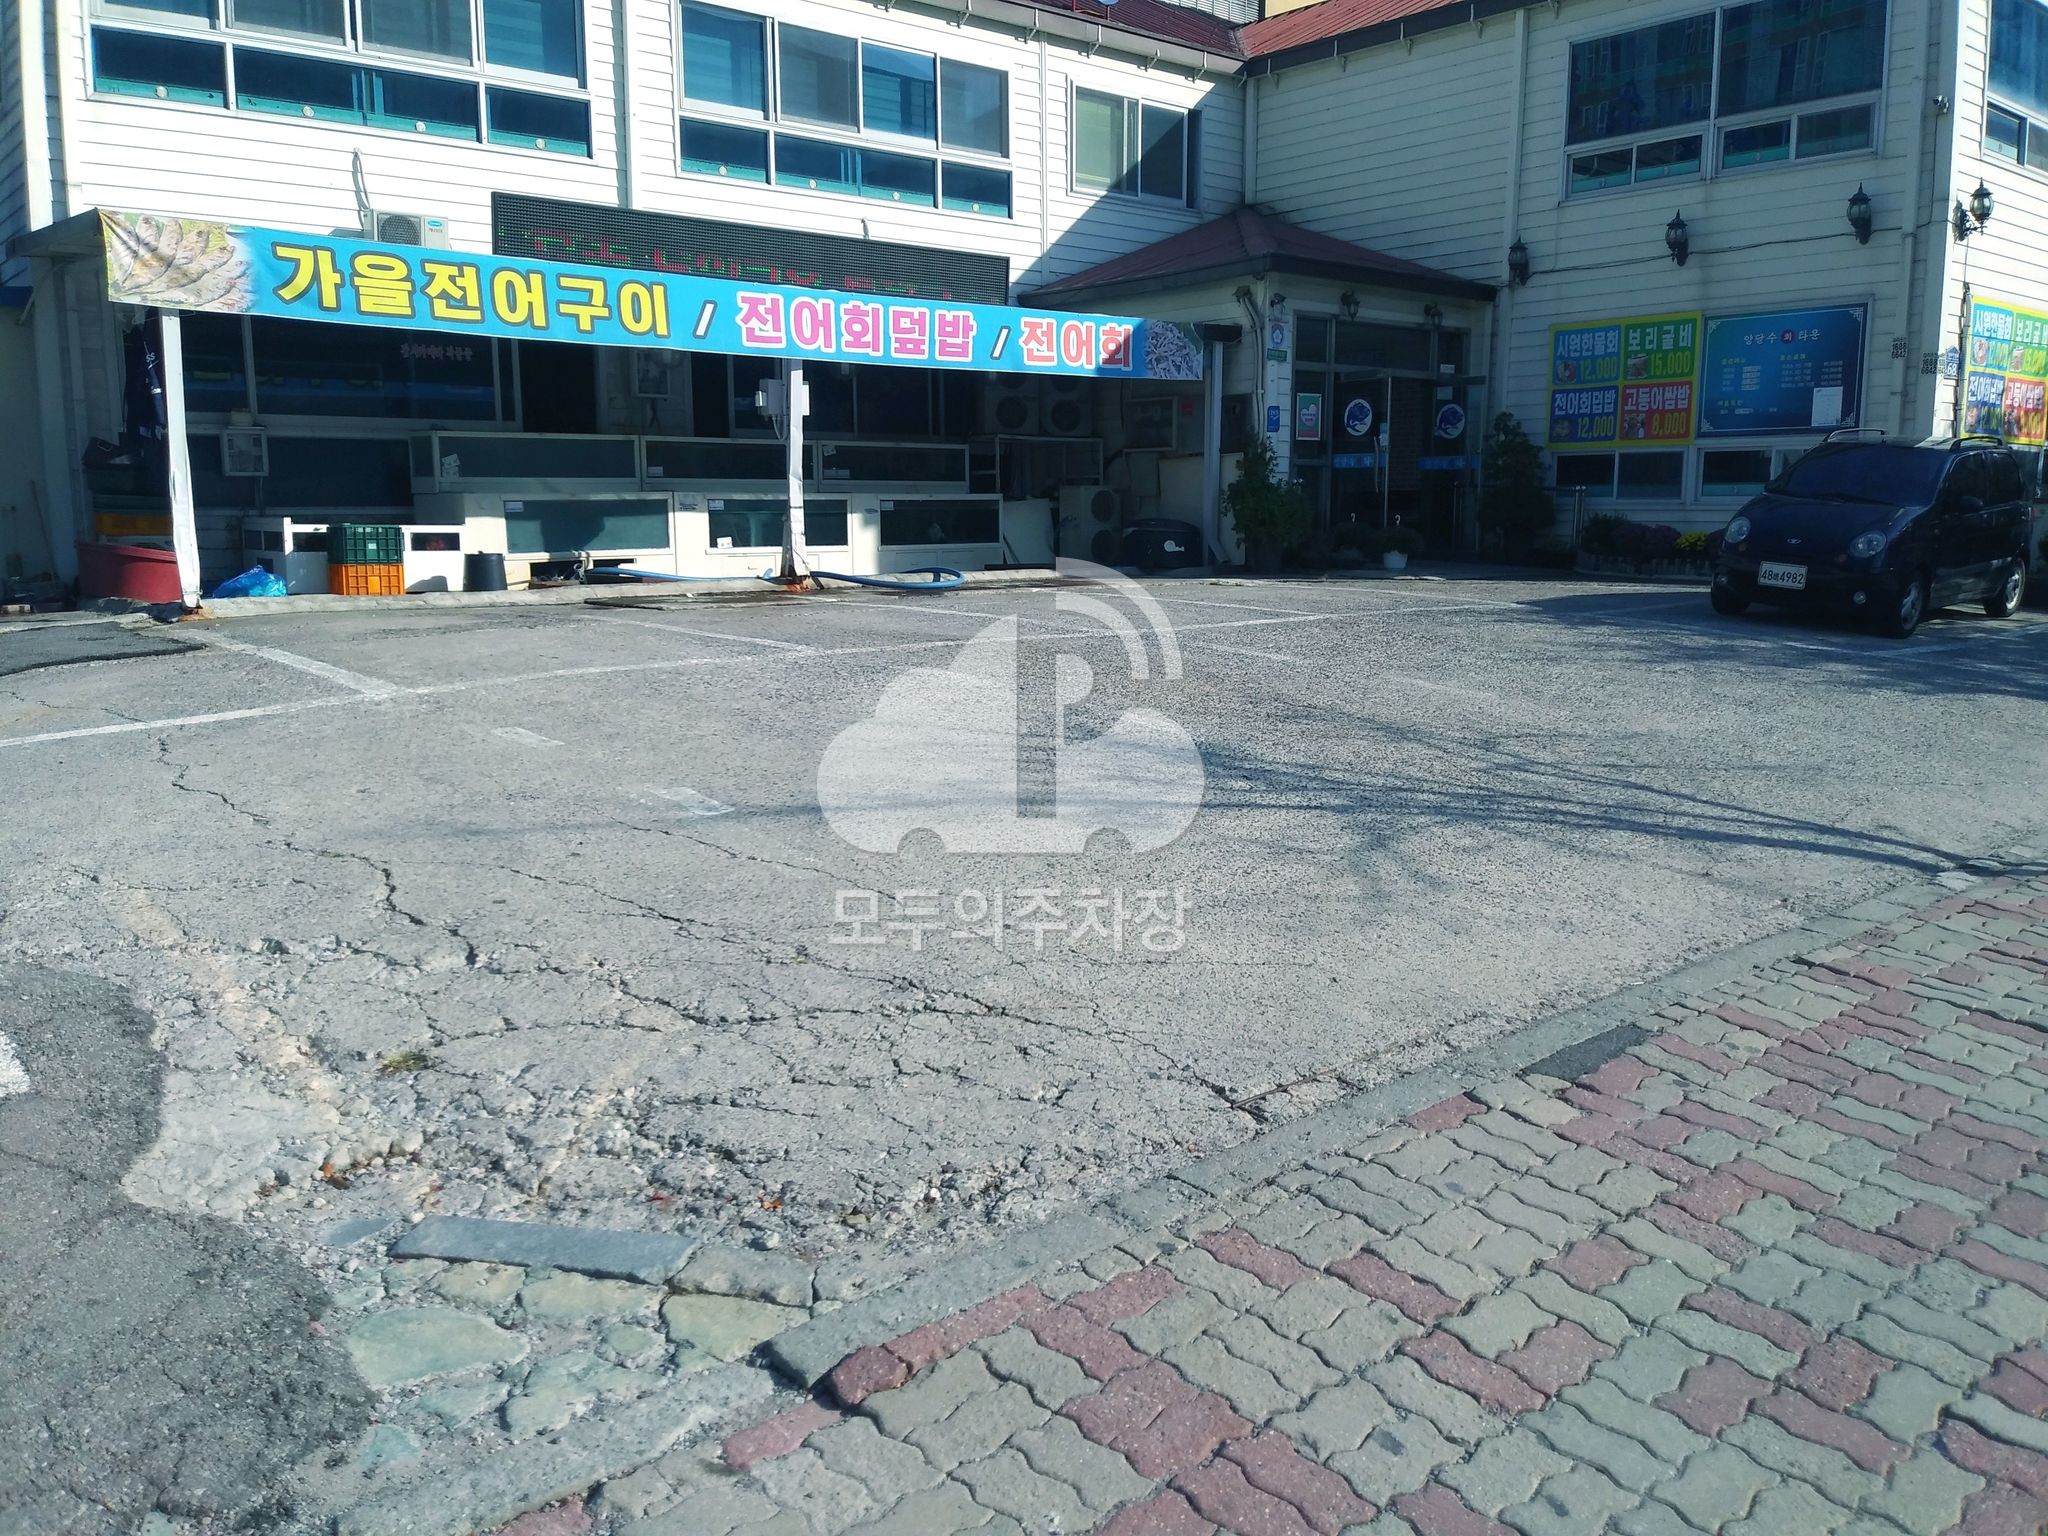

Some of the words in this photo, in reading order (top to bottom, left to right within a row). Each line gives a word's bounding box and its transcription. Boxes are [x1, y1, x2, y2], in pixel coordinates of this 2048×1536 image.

[272, 242, 670, 338] 가을전어구이
[736, 292, 977, 360] 전어회덮밥
[1018, 317, 1135, 370] 전어회
[1556, 330, 1619, 358] 시원한물회
[1579, 357, 1617, 382] 12,000
[1650, 351, 1691, 377] 15,000
[1947, 362, 1958, 375] 68
[1624, 385, 1691, 411] 고등어쌈밥
[1577, 415, 1615, 439] 12,000
[1652, 412, 1687, 436] 8,000
